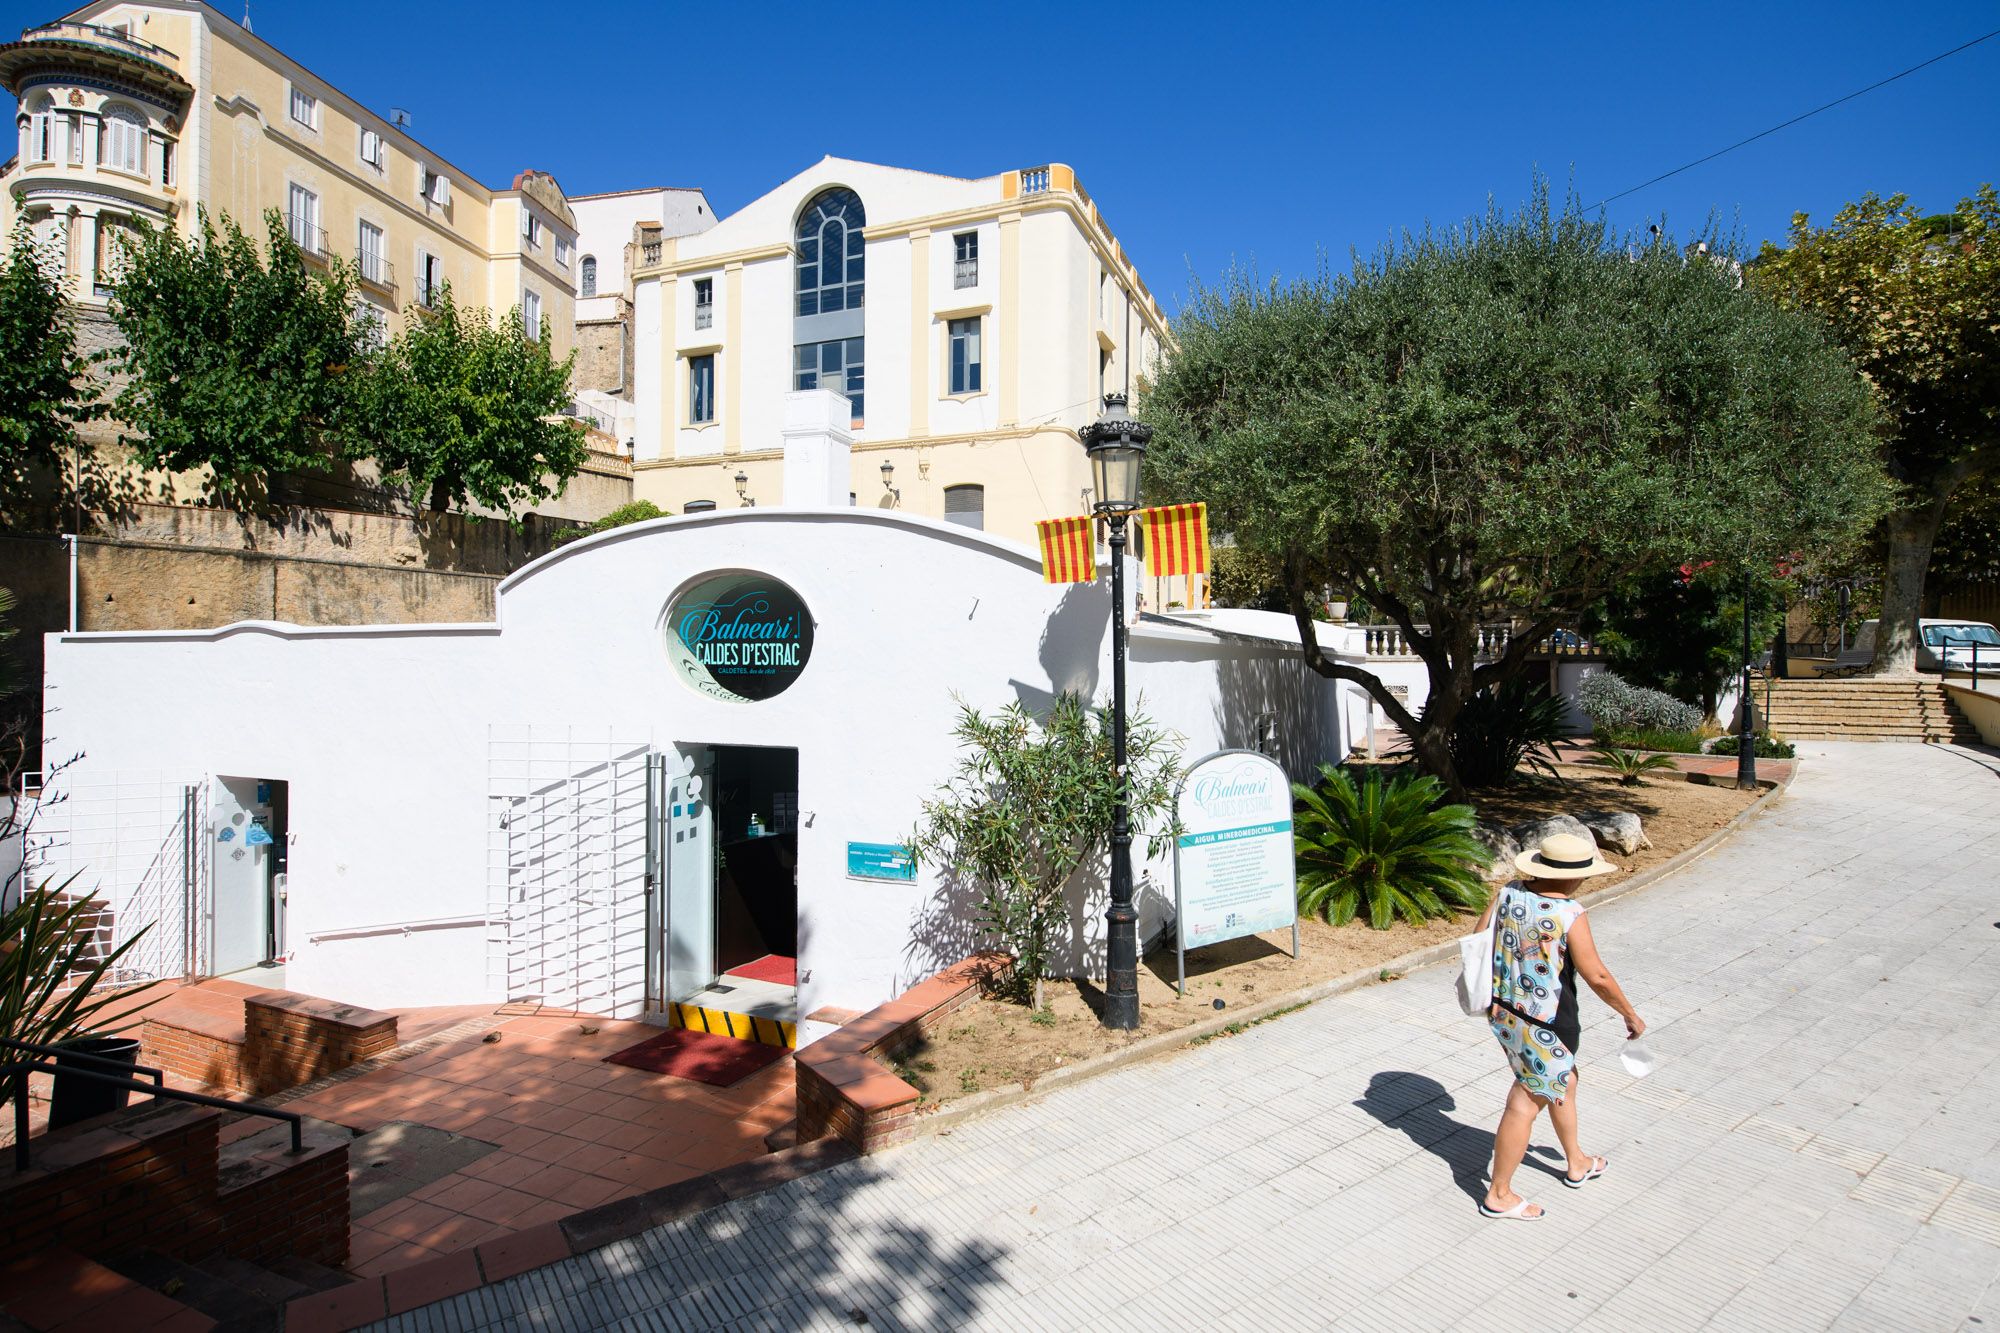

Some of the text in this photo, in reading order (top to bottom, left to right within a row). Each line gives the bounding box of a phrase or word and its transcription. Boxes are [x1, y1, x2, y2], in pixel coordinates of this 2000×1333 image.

[679, 608, 792, 645] Balneari
[696, 643, 800, 666] CALDES D'ESTRAC
[1195, 776, 1268, 804] Balneari
[1207, 799, 1236, 818] CALDES
[1195, 825, 1275, 844] AIGUA MINEROMEDICINAL
